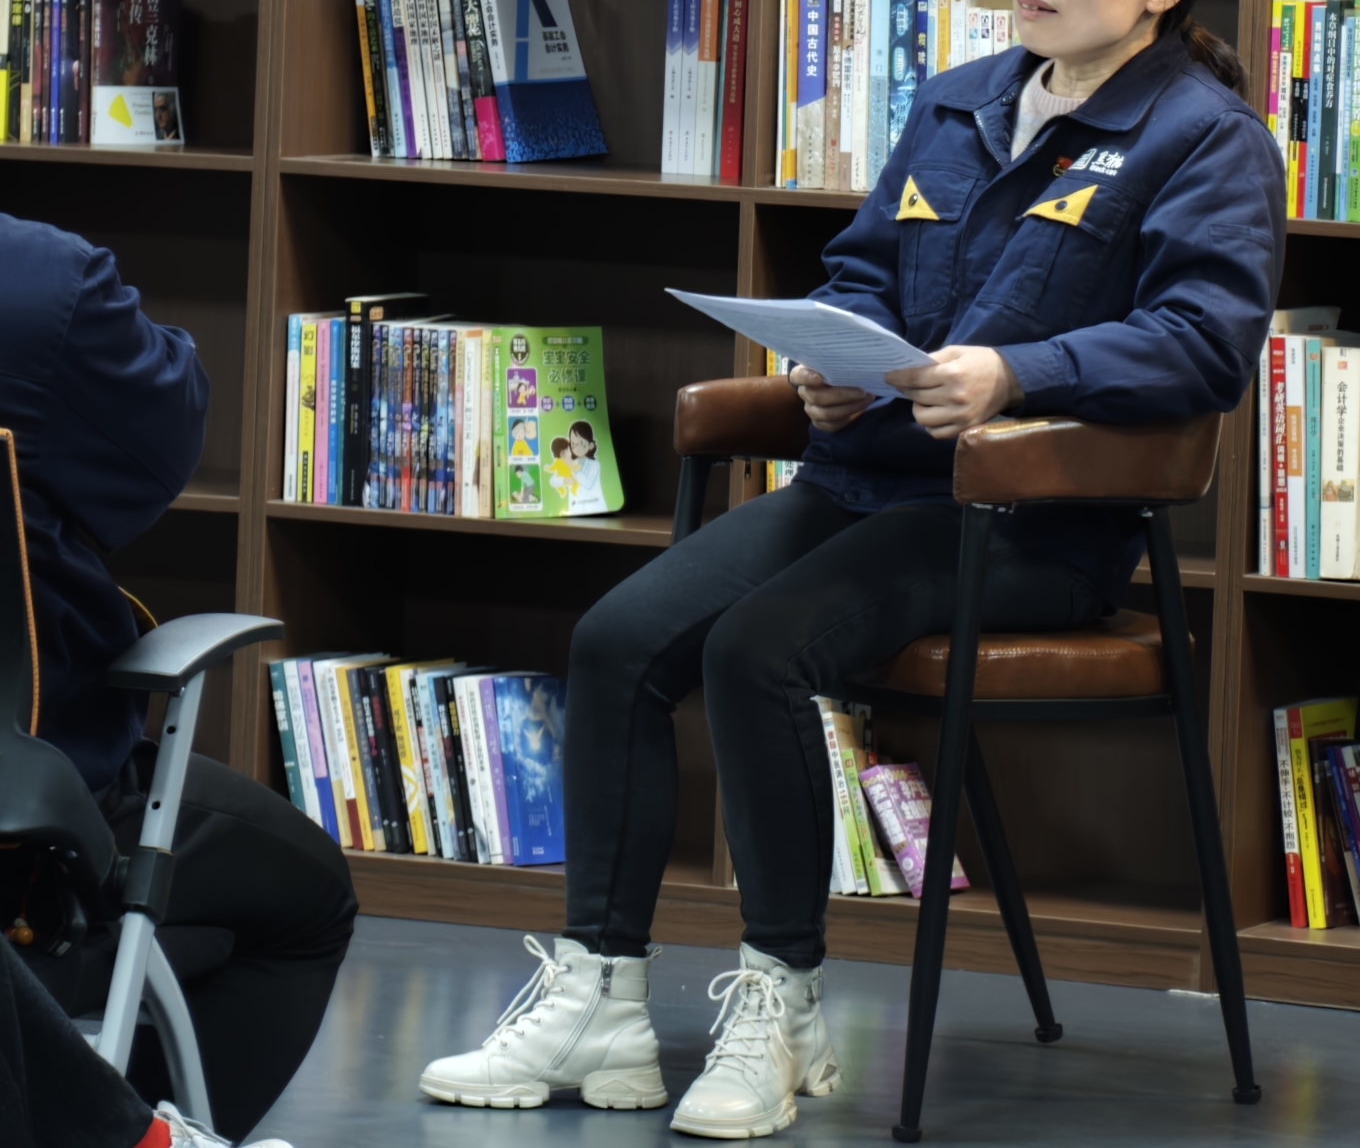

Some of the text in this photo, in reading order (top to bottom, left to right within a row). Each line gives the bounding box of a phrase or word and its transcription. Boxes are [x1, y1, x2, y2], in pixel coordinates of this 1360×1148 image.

[542, 31, 566, 41] 基层工会
[545, 42, 569, 53] 会计实务
[806, 10, 819, 77] 中国古代史
[843, 51, 852, 91] 傅雷家书
[1325, 12, 1337, 108] 本草纲目中的对症食养方
[1093, 151, 1125, 168] 黑猫
[542, 349, 590, 365] 宝宝安全
[548, 368, 586, 385] 必修课
[1336, 381, 1348, 414] 会计学
[1274, 382, 1285, 444] 考研英语词汇
